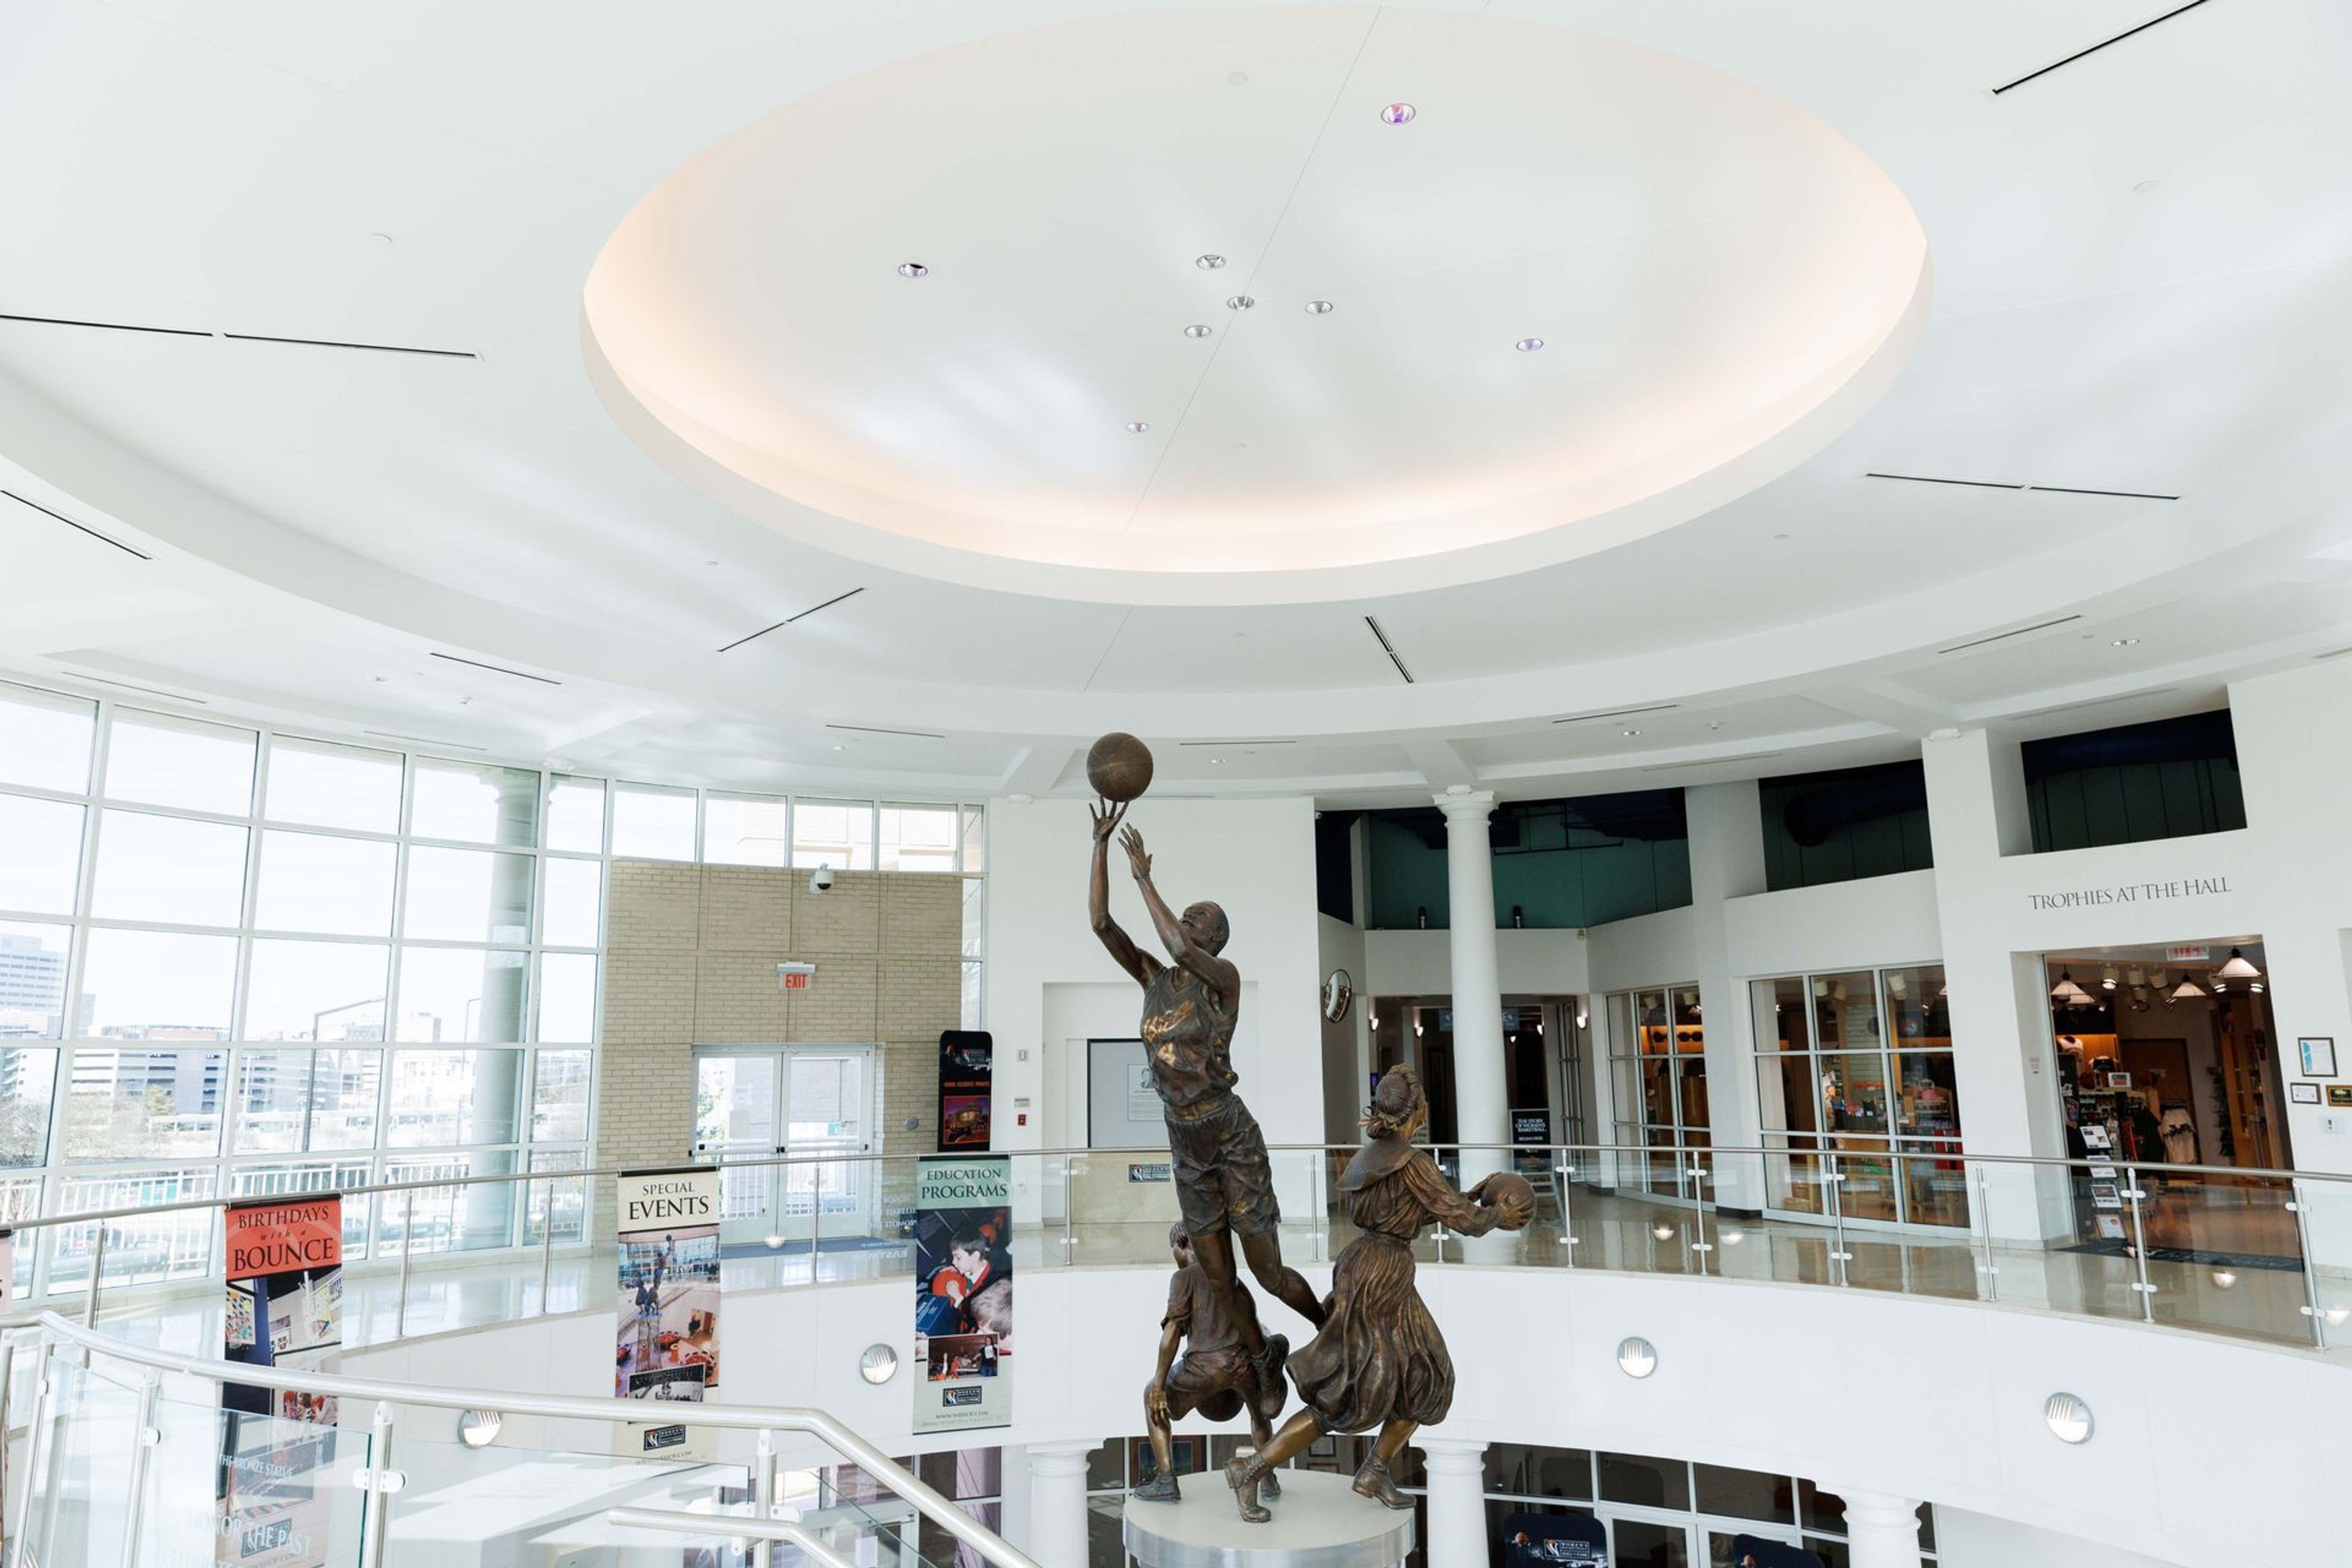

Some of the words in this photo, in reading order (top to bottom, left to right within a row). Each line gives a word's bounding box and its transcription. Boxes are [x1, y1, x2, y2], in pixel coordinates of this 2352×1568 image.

[2029, 888, 2113, 910] TROPHIES
[2116, 886, 2139, 903] AT
[2141, 882, 2180, 900] THE
[2184, 876, 2232, 895] HALL
[785, 973, 807, 989] EXIT
[927, 1168, 1001, 1180] EDUCATION
[643, 1182, 695, 1195] SPECIAL
[922, 1183, 1008, 1199] PROGRAMS
[629, 1196, 709, 1219] EVENTS
[238, 1205, 329, 1229] BIRTHDAYS
[261, 1228, 291, 1240] with
[234, 1237, 333, 1271] BOUNCE
